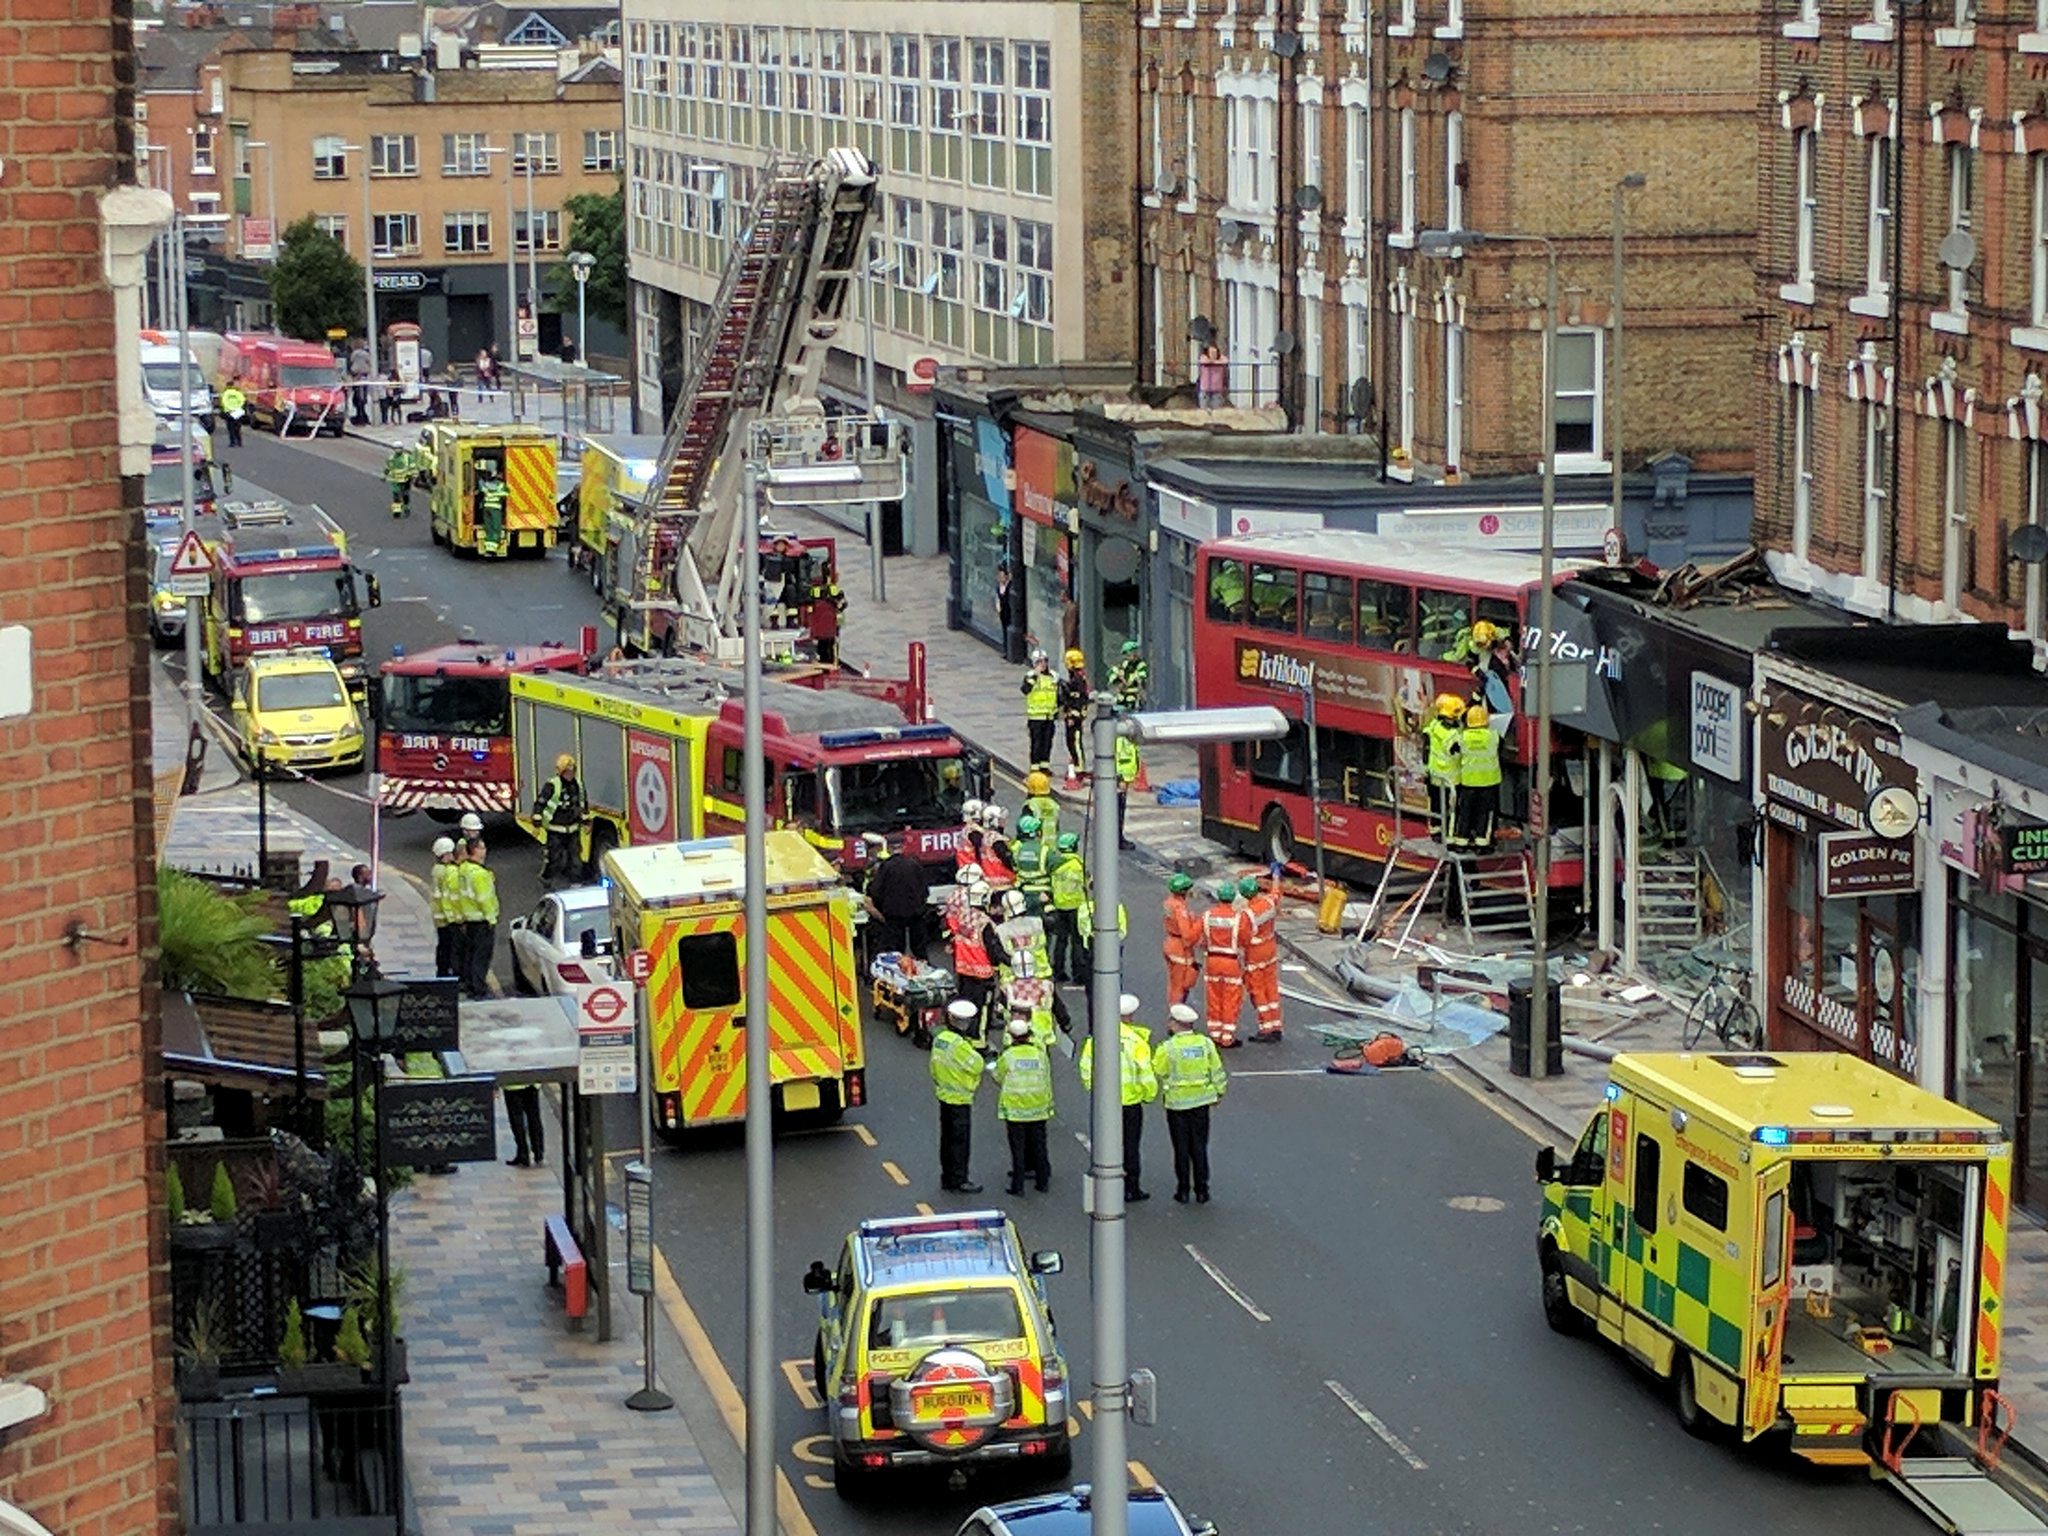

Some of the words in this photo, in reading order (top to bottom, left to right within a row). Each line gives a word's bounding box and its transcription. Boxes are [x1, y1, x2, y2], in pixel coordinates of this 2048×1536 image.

[1830, 847, 1888, 868] GOLDEN
[1890, 848, 1912, 865] PIE
[634, 955, 648, 976] E
[984, 1340, 1024, 1354] POLICE
[871, 1352, 911, 1363] POLICE
